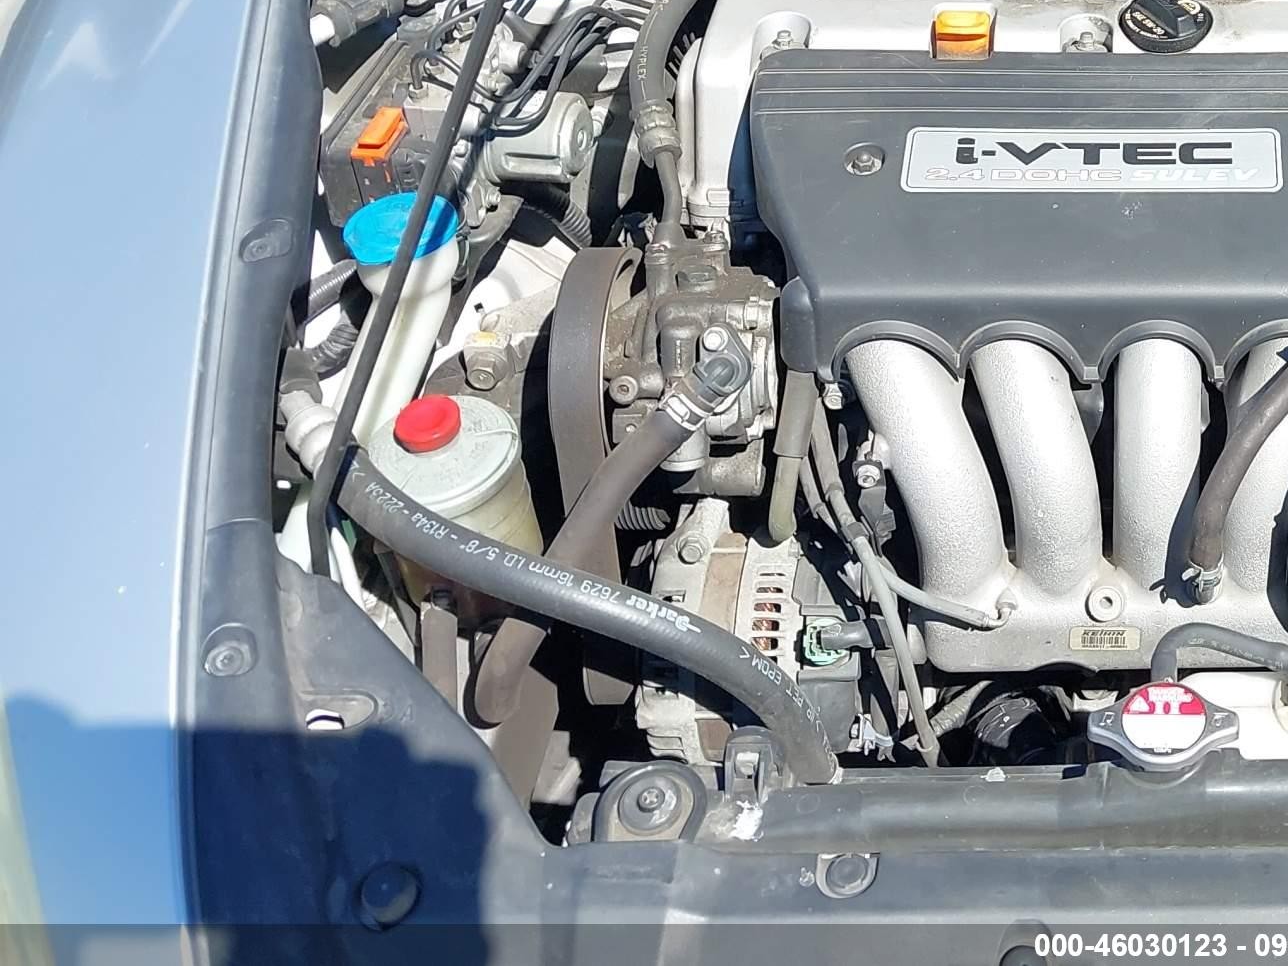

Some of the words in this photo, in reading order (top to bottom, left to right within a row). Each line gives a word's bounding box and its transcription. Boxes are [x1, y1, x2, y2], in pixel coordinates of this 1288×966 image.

[955, 136, 1233, 166] i-VTEC
[923, 167, 986, 182] 2.4
[990, 168, 1122, 182] DOHC
[1128, 167, 1260, 183] SULEV
[411, 512, 450, 540] R134a
[528, 561, 575, 588] 16mm
[580, 580, 621, 604] 7629
[626, 594, 702, 634] Parker
